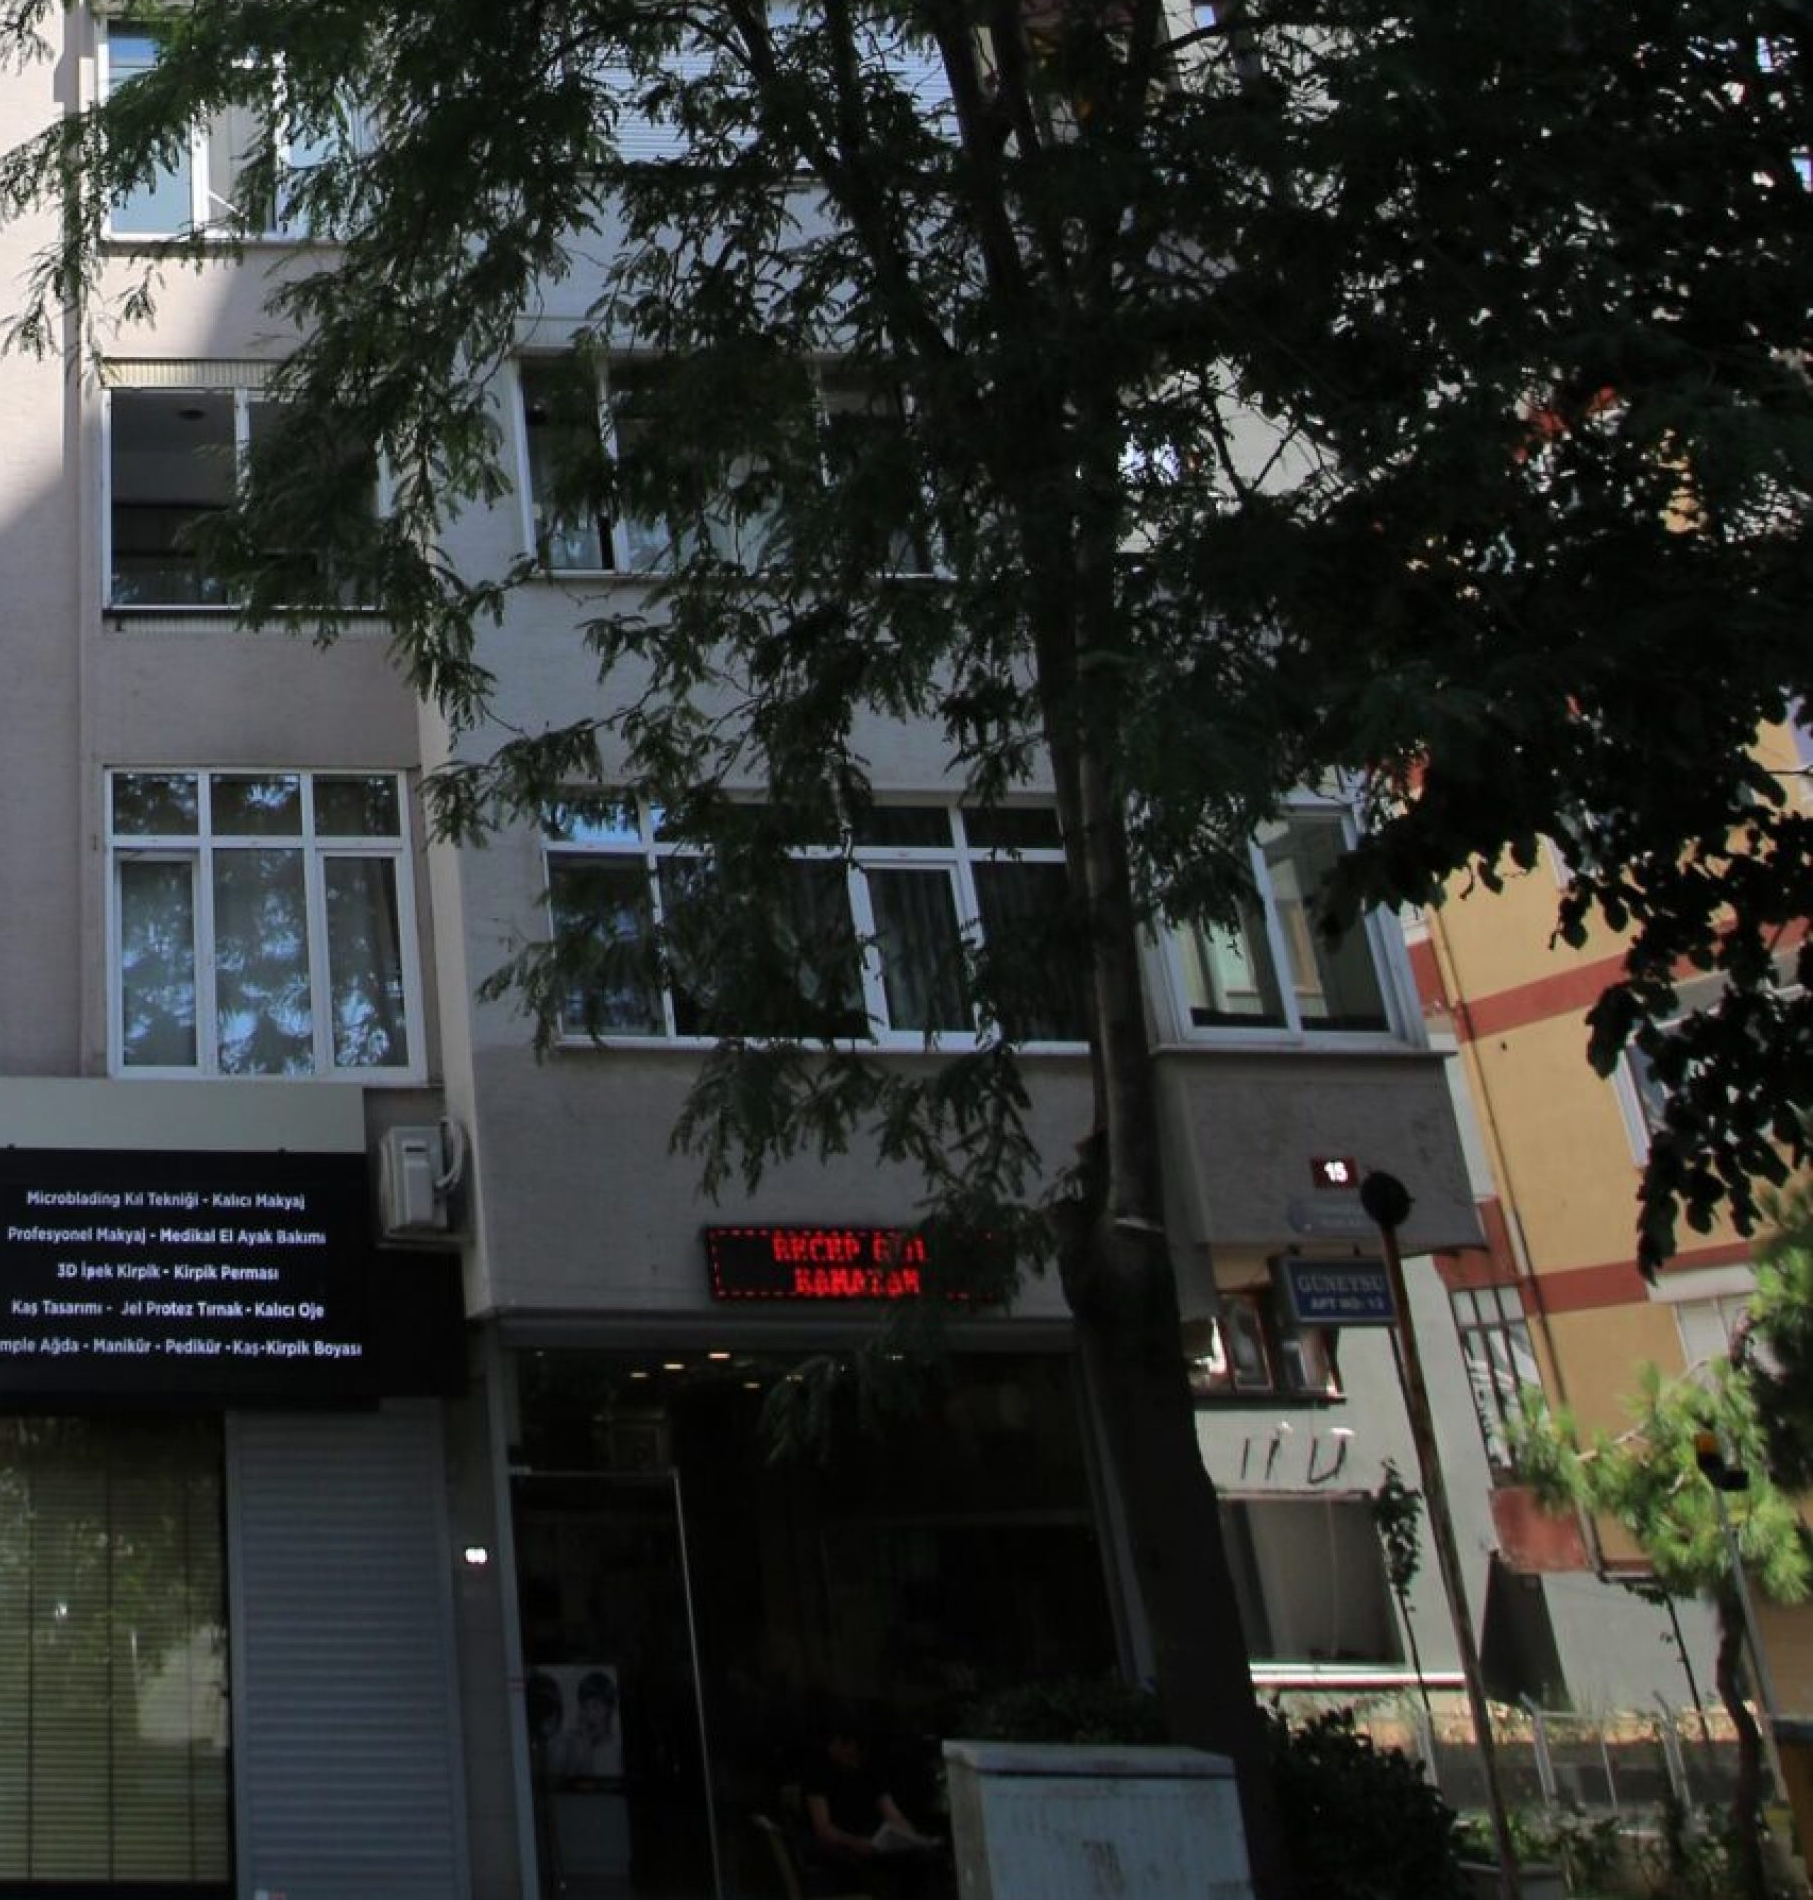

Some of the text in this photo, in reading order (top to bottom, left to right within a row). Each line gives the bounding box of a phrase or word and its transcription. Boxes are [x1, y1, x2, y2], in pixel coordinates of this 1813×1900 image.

[26, 1190, 121, 1209] Microblading
[147, 1191, 200, 1210] Tekniği
[212, 1192, 252, 1208] Kalıcı
[254, 1193, 306, 1211] Makyaj
[6, 1226, 93, 1244] Profesyonel
[95, 1227, 147, 1246] Makyaj
[159, 1227, 216, 1244] Medikal
[218, 1228, 235, 1244] El
[236, 1229, 274, 1247] Ayak
[275, 1229, 327, 1245] Bakımı
[57, 1262, 78, 1279] 3D
[80, 1260, 114, 1281] İpek
[116, 1263, 160, 1282] Kirpik
[173, 1263, 219, 1283] Kirpik
[220, 1264, 280, 1281] Perması
[10, 1299, 39, 1317] Kaş
[42, 1299, 104, 1316] Tasarımı
[120, 1300, 144, 1317] Jel
[146, 1300, 194, 1317] Protez
[196, 1300, 244, 1318] Tırnak
[254, 1301, 295, 1319] Kalıcı
[297, 1302, 325, 1321] Oje
[38, 1336, 80, 1356] Ağda
[93, 1338, 152, 1355] Manikür
[165, 1338, 222, 1355] Pedikür
[312, 1340, 363, 1359] Boyası
